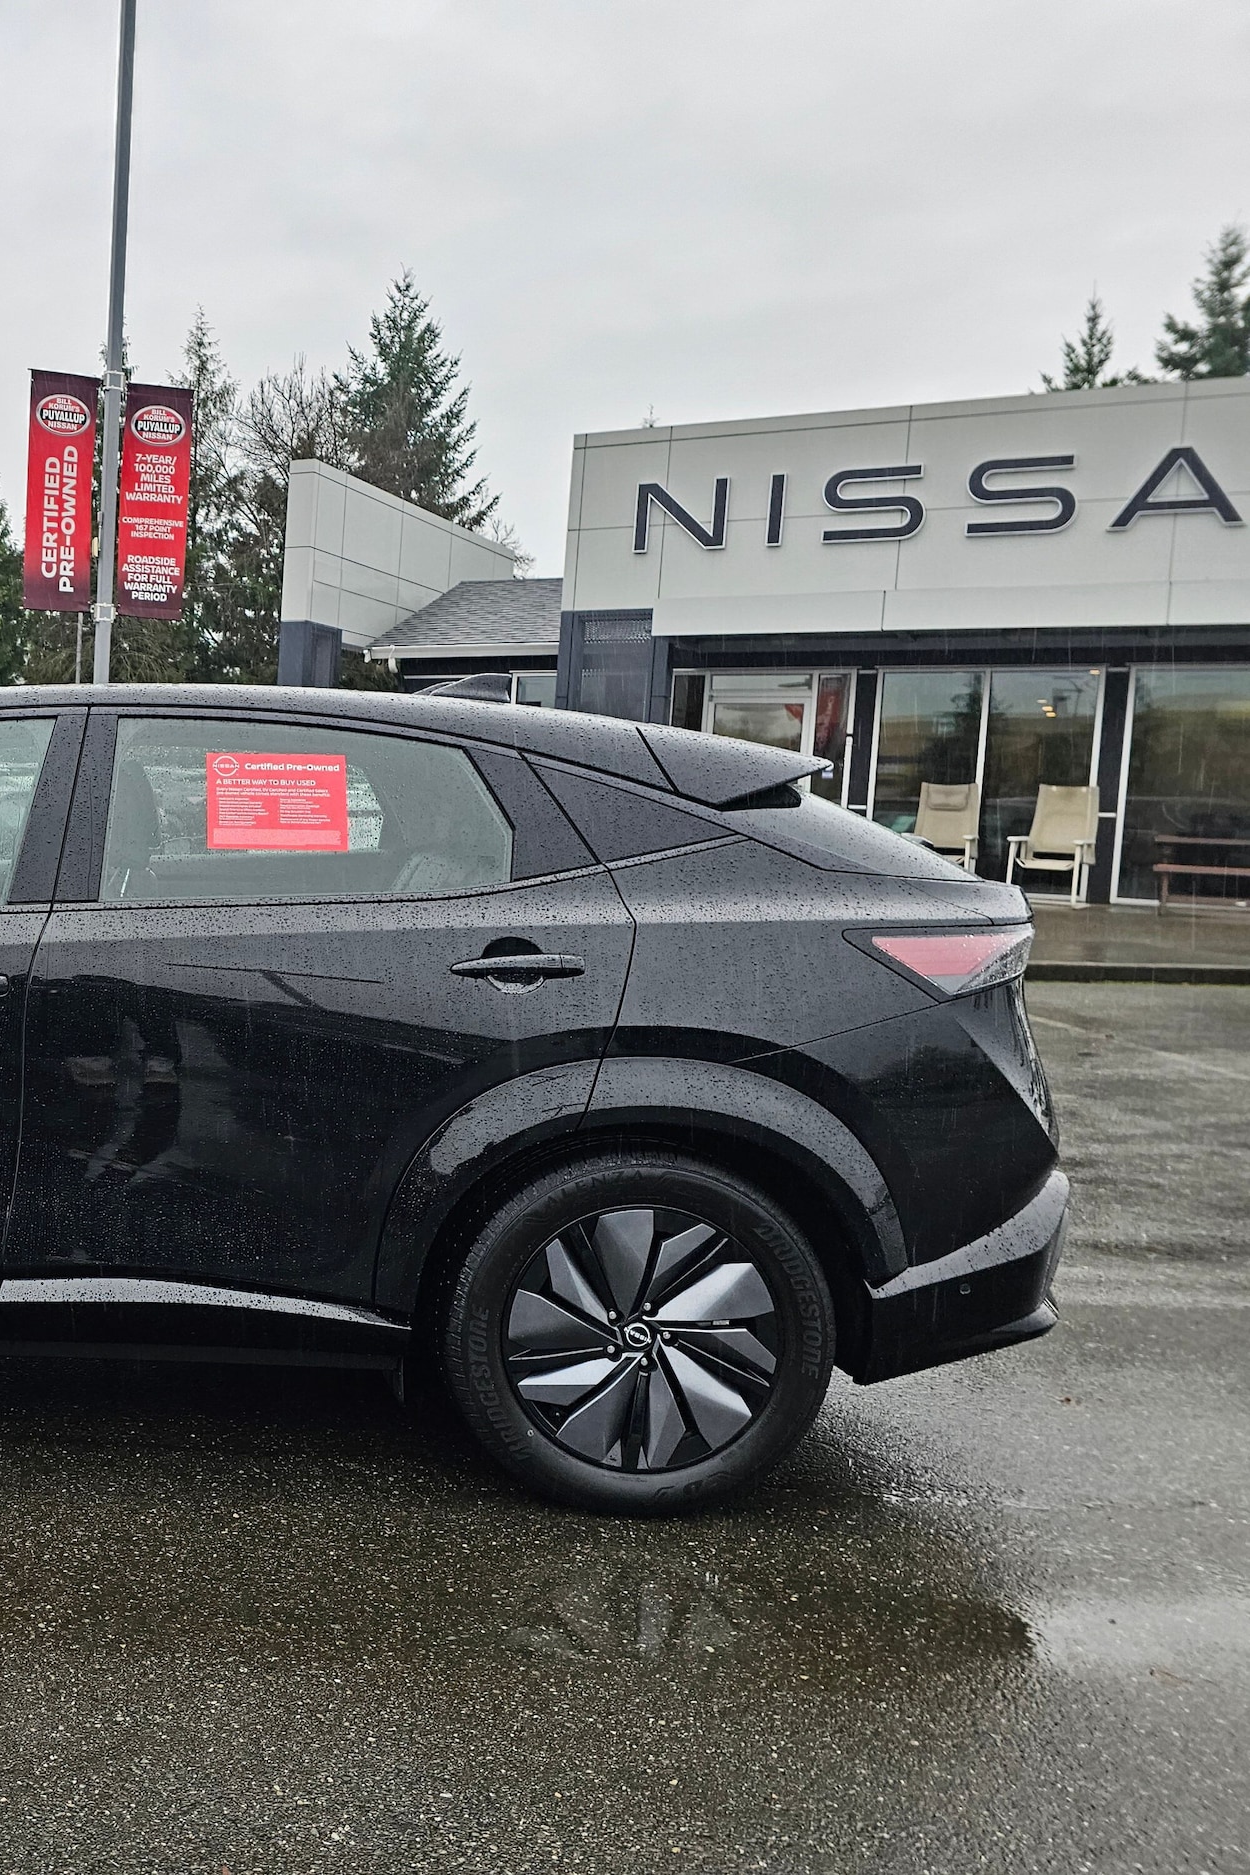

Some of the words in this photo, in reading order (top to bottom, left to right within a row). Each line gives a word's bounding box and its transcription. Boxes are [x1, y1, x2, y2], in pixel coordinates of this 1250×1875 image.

[56, 397, 72, 405] BILL
[41, 409, 86, 424] PUYALLUP
[151, 408, 167, 416] BILL
[47, 421, 78, 431] NISSAN
[137, 420, 181, 433] PUYALLUP
[142, 431, 173, 440] NISSAN
[135, 453, 177, 465] 7-YEAR/
[134, 463, 175, 474] 100,000
[140, 473, 171, 483] MILES
[134, 482, 175, 493] LIMITED
[125, 491, 183, 504] WARRANTY
[41, 456, 61, 579] CERTIFIED
[58, 445, 78, 593] PRE-OWNED
[122, 516, 184, 528] COMPREHENSIVE
[149, 524, 172, 533] POINT
[131, 530, 175, 540] INSPECTION
[127, 554, 176, 566] ROADSIDE
[122, 564, 180, 576] ASSISTANCE
[127, 573, 148, 583] FOR
[150, 575, 172, 584] FULL
[124, 581, 178, 594] WARRANTY
[131, 591, 167, 602] PERIOD
[244, 762, 285, 771] Certified
[286, 763, 340, 772] Pre-Owned
[752, 1221, 821, 1380] BRIDGESTONE
[466, 1304, 531, 1461] BRIDGESTONE
